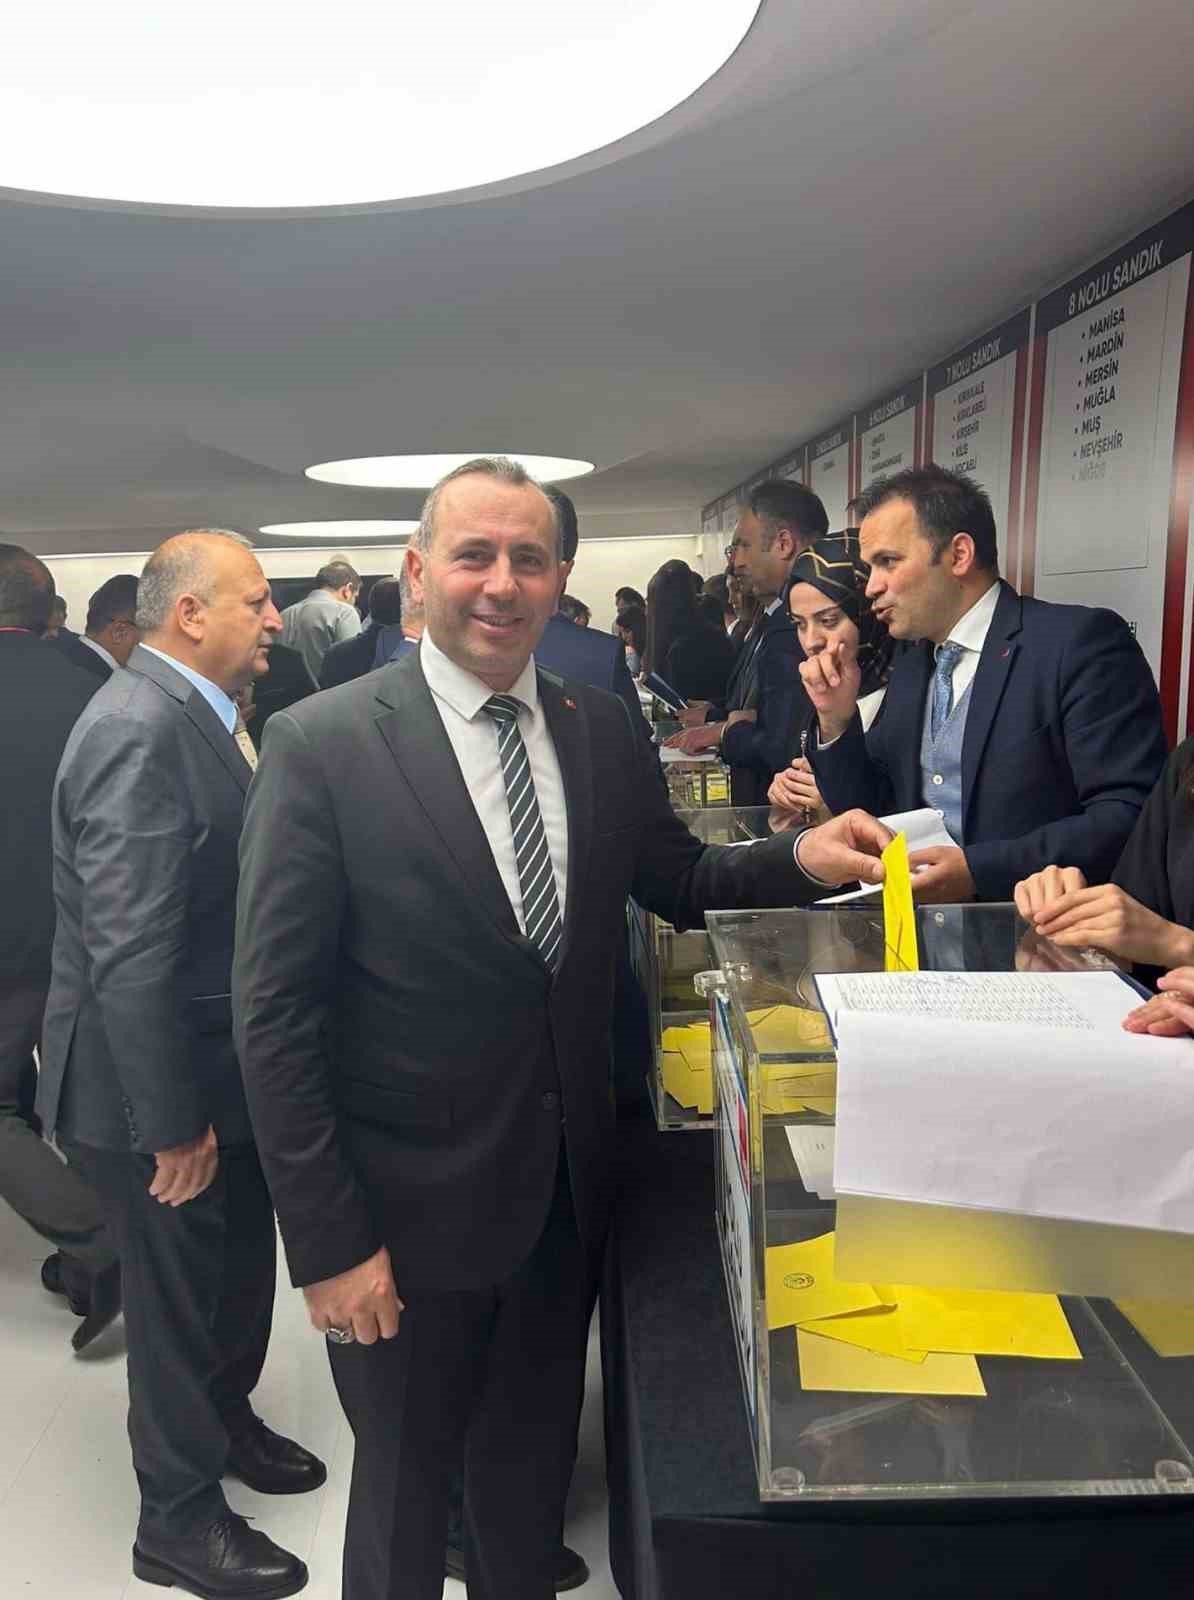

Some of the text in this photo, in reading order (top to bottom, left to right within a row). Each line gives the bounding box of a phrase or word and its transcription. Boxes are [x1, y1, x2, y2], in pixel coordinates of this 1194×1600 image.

[1068, 239, 1164, 315] 8 NOLU SANDIK
[1089, 307, 1125, 340] MANİSA
[1087, 331, 1124, 364] MARDİN
[1085, 358, 1119, 388] MERSİN
[1083, 385, 1116, 413] MUĞLA
[1081, 415, 1101, 435] MUŞ
